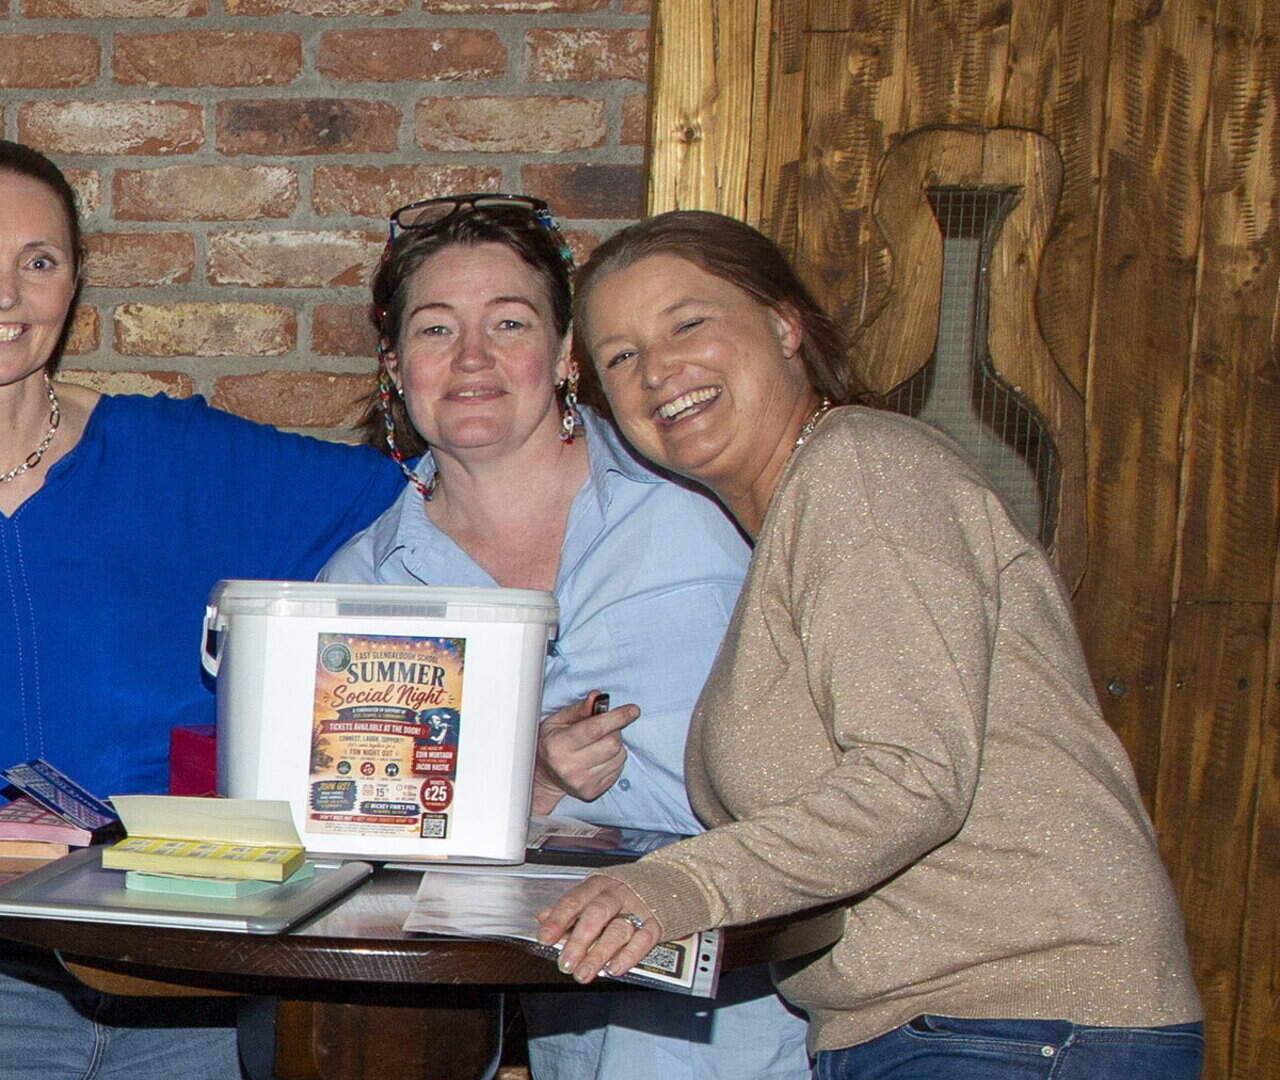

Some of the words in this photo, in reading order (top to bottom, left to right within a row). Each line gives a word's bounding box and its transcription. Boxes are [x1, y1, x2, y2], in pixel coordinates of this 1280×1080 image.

[346, 661, 445, 687] SUMMER
[330, 684, 394, 708] Social
[396, 684, 447, 710] Night
[330, 722, 352, 731] TICKETS
[354, 723, 382, 732] AVAILABLE
[392, 725, 402, 733] THE
[376, 788, 384, 797] 15
[424, 786, 447, 801] €25
